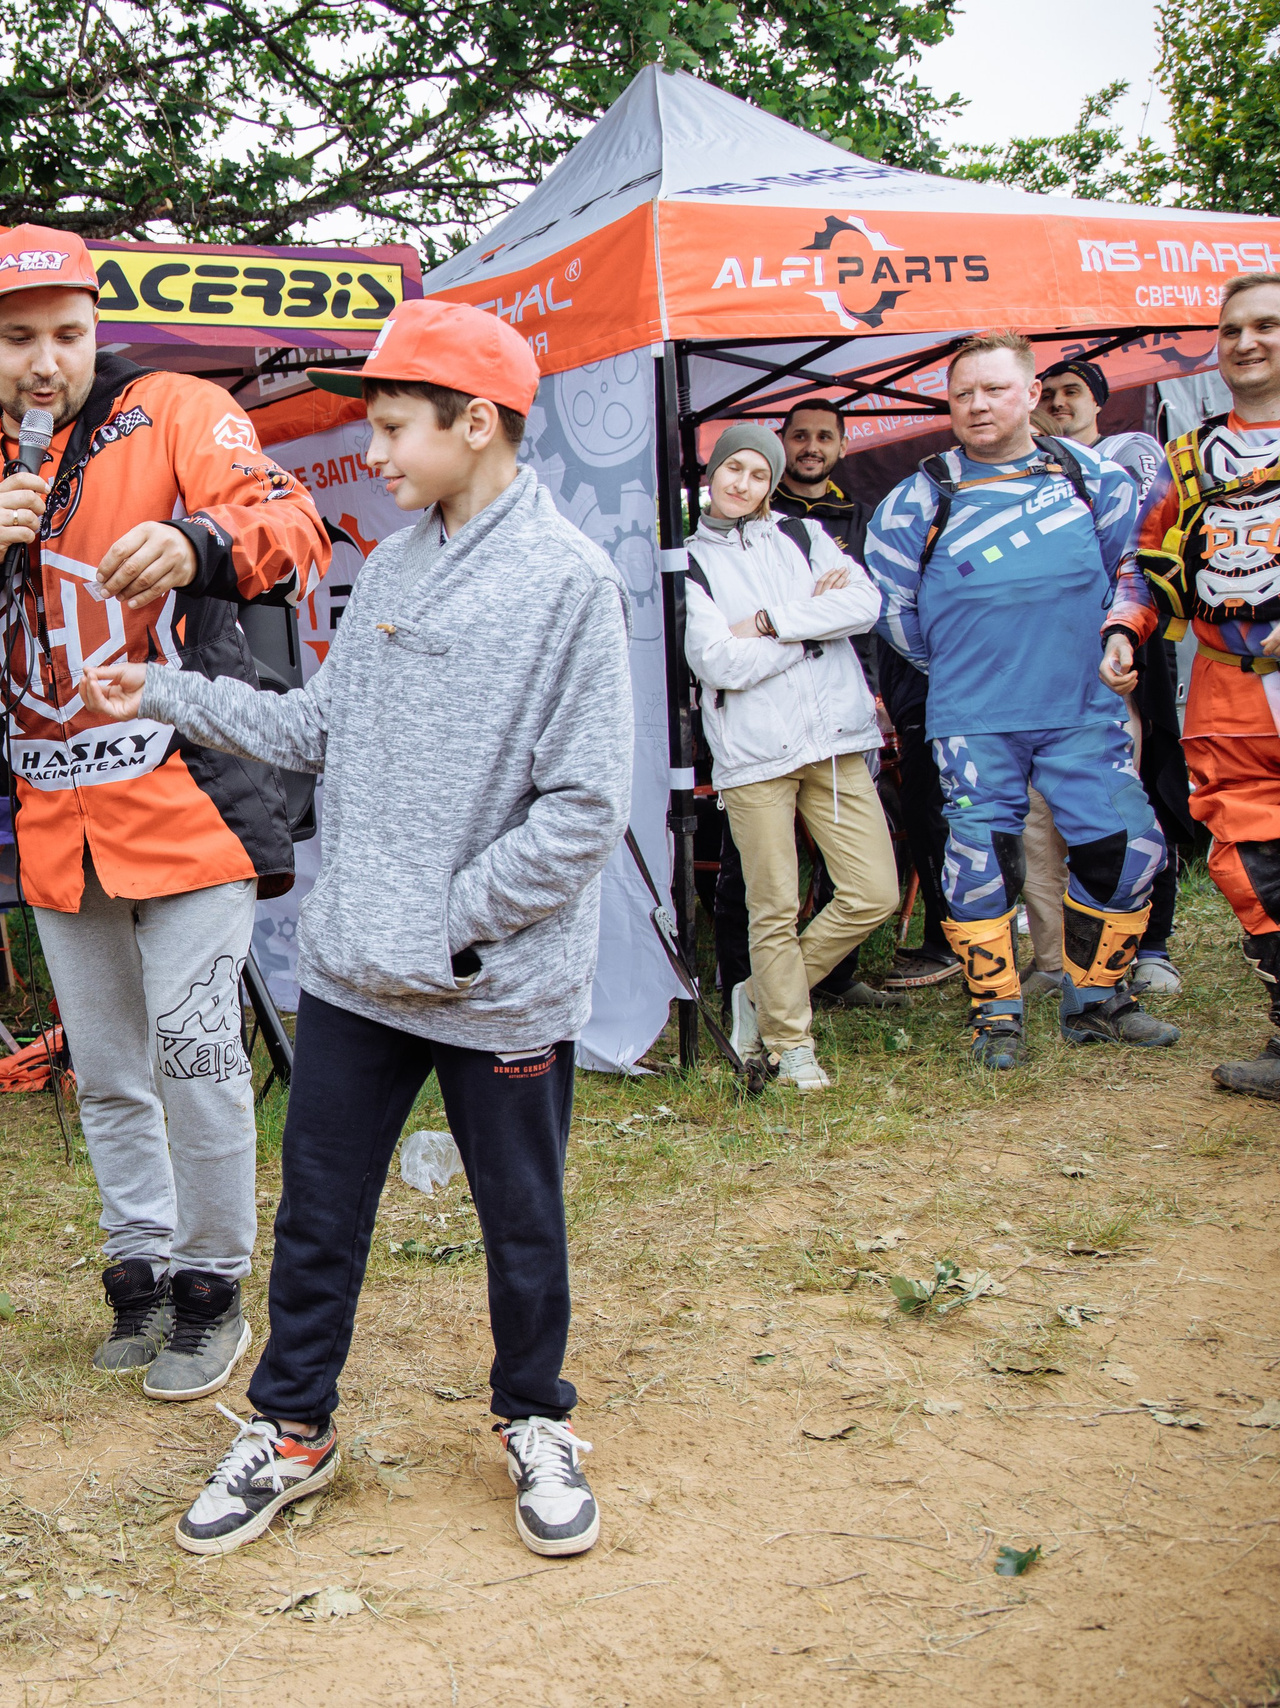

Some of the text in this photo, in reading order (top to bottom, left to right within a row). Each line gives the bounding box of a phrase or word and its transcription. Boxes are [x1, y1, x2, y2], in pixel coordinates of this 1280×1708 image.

[19, 261, 61, 272] RACING
[837, 254, 990, 285] PARTS
[1135, 285, 1202, 307] СВЕЧИ
[22, 731, 159, 770] HASKY
[904, 973, 939, 987] crocs
